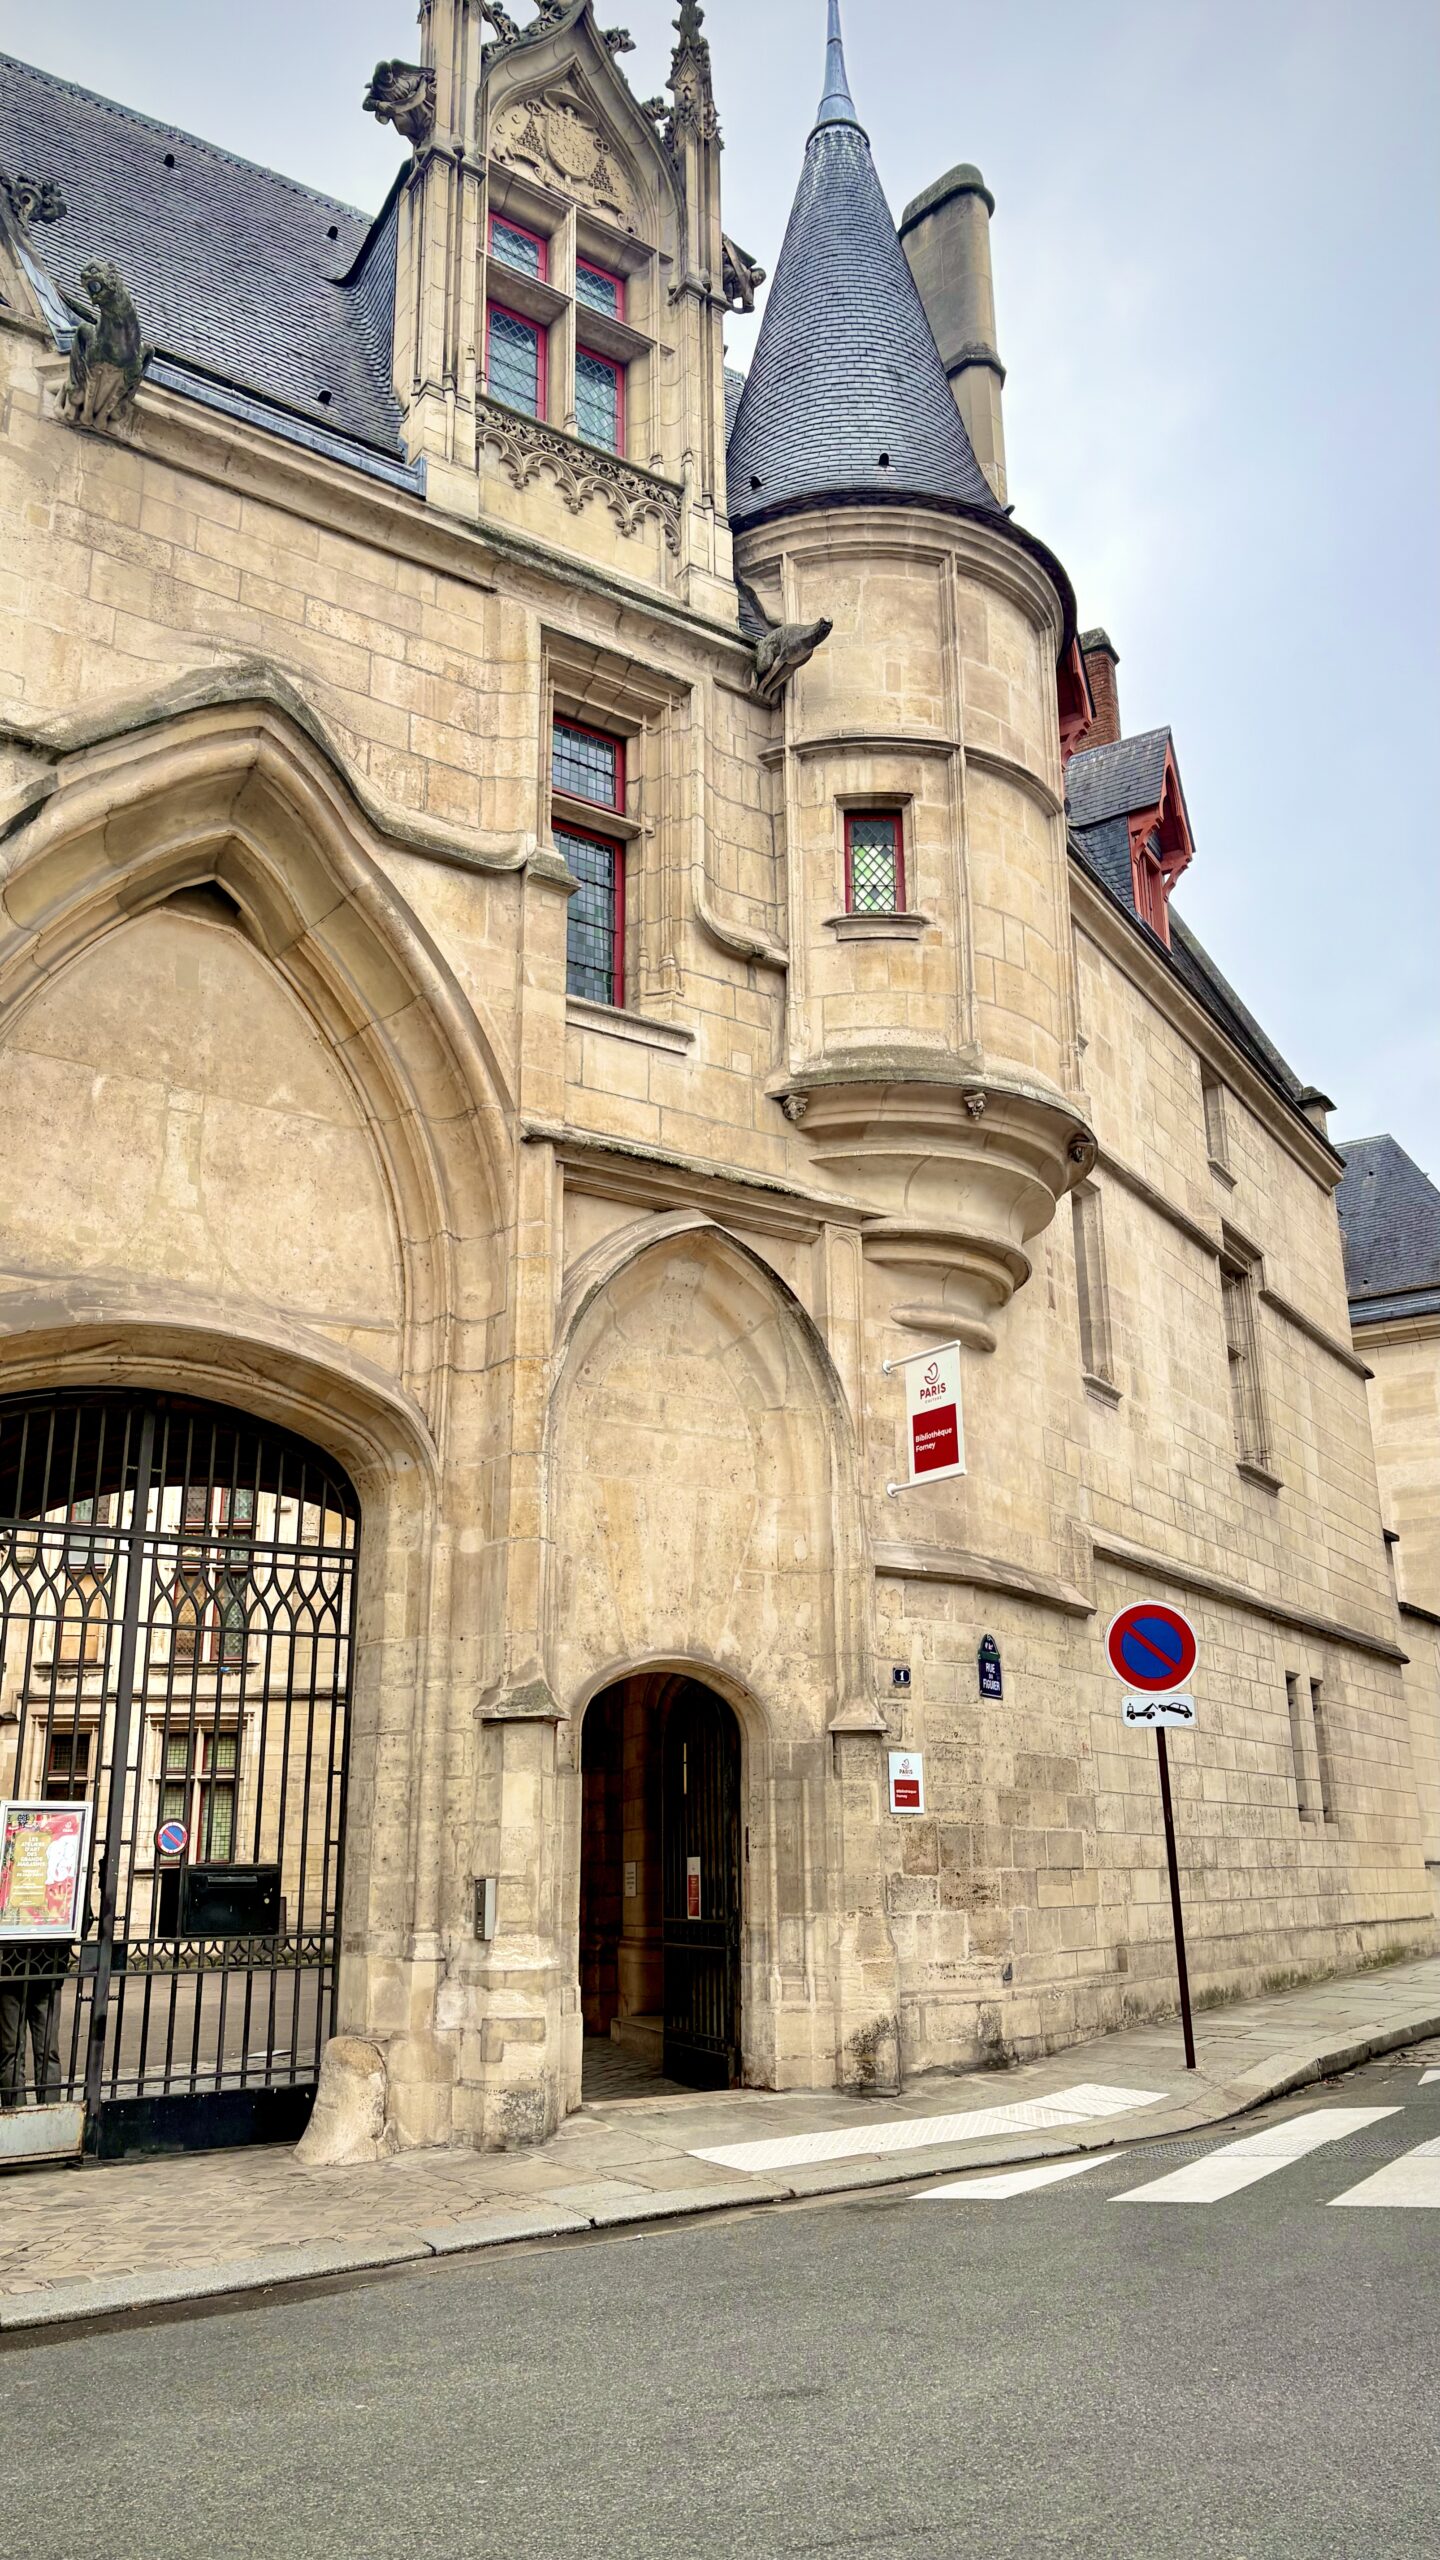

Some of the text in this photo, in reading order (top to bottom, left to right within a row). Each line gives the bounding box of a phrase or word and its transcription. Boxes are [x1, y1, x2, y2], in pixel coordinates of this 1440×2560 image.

[920, 1383, 946, 1399] PARIS
[915, 1427, 952, 1443] Bibliothèque
[915, 1442, 936, 1453] Forney
[985, 1662, 996, 1674] RUE
[899, 1670, 905, 1681] 1
[982, 1678, 1000, 1691] FIGUIER
